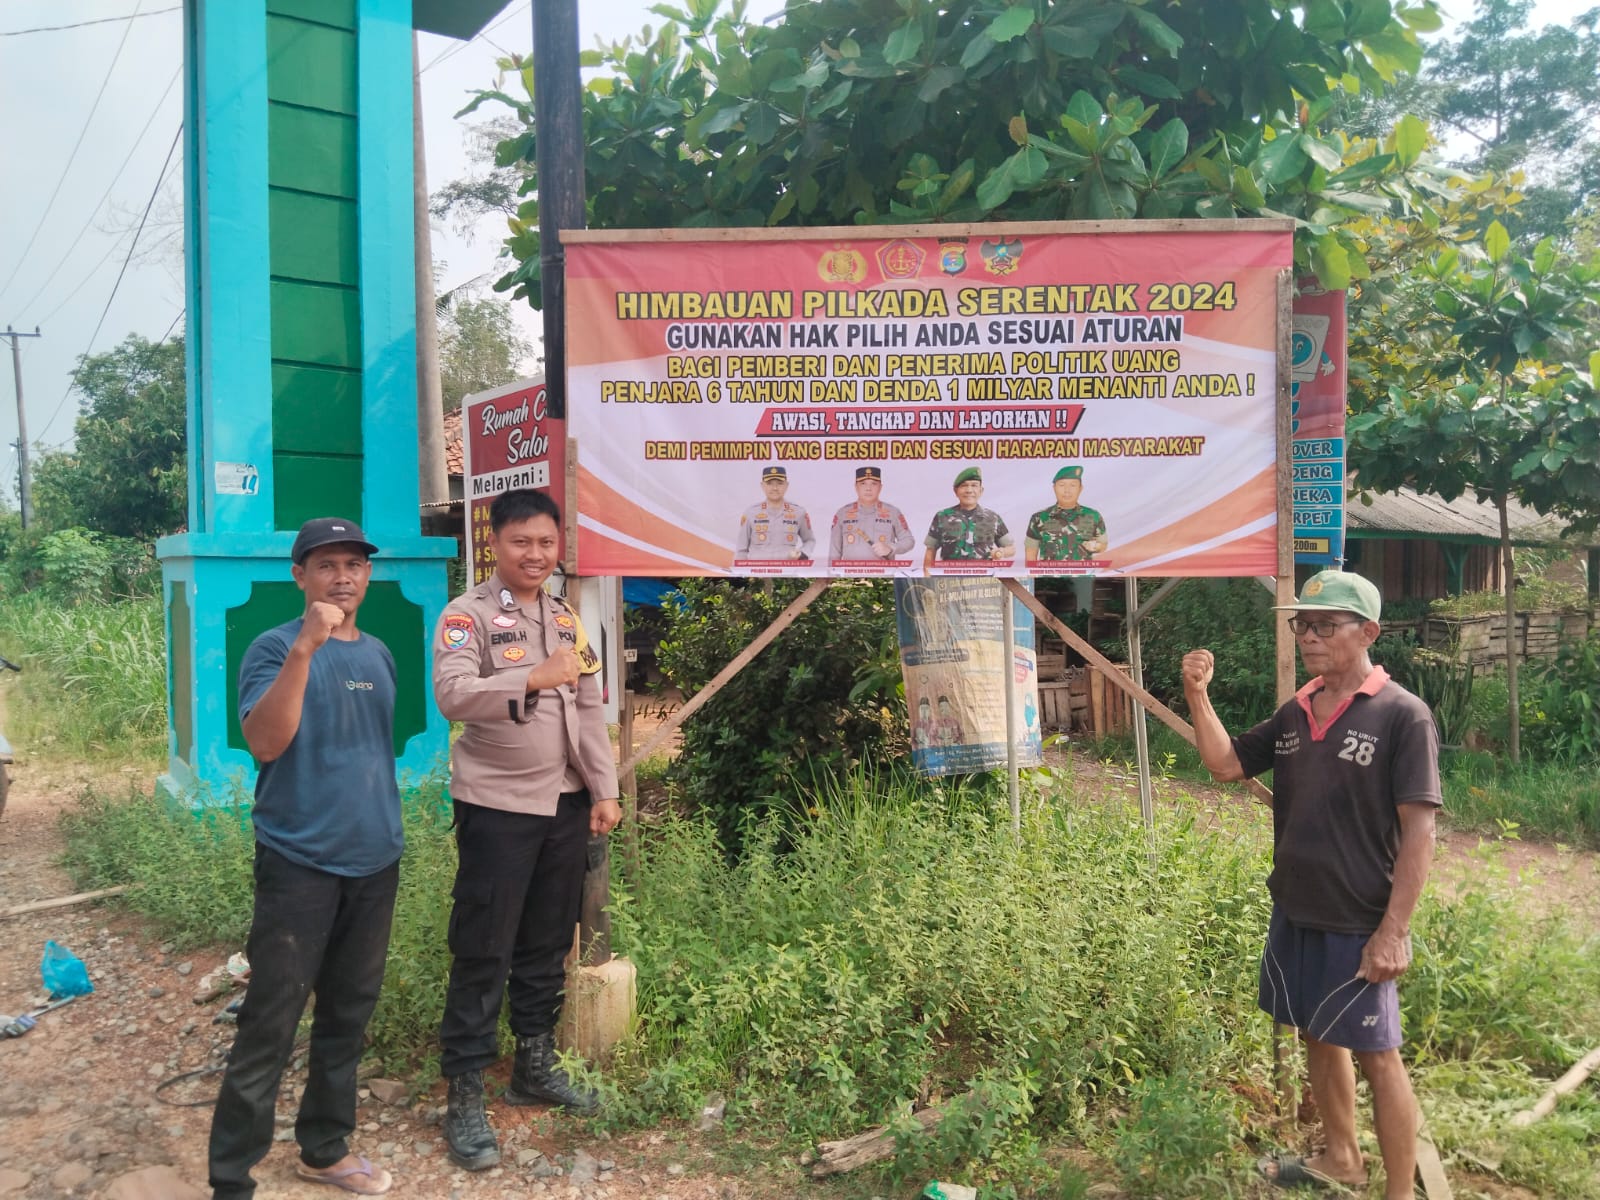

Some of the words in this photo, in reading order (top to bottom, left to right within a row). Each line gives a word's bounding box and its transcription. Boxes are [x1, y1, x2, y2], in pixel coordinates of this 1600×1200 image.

[617, 291, 793, 319] HIMBAUAN
[802, 289, 949, 318] PILKADA
[958, 283, 1140, 315] SERENTAK
[1149, 282, 1237, 311] 2024
[667, 324, 782, 349] GUNAKAN
[789, 324, 838, 348] HAK
[847, 323, 908, 347] PILIH
[915, 321, 979, 347] ANDA
[988, 319, 1074, 345] SESUAI
[1082, 317, 1182, 342] ATURAN
[668, 356, 720, 378] BAGI
[728, 355, 826, 378] PEMBERI
[833, 355, 879, 377] DAN
[887, 352, 1004, 377] PENERIMA
[1012, 351, 1105, 374] POLITIK
[1113, 349, 1179, 373] UANG
[601, 380, 703, 402] PENJARA
[707, 381, 721, 403] 6
[727, 380, 803, 402] TAHUN
[811, 380, 856, 402] DAN
[863, 379, 941, 401] DENDA
[948, 379, 959, 401] 1
[967, 378, 1053, 400] MILYAR
[1059, 375, 1166, 398] MENANTI
[1173, 373, 1241, 397] ANDA
[1247, 373, 1256, 396] !
[481, 398, 529, 437] Rumah
[533, 389, 548, 421] C
[771, 412, 831, 433] AWASI,
[835, 411, 915, 431] TANGKAP
[919, 410, 954, 430] DAN
[958, 410, 1051, 429] LAPORKAN
[1055, 409, 1068, 428] !!
[645, 441, 686, 460] DEMI
[690, 441, 771, 460] PEMIMPIN
[775, 441, 820, 460] YANG
[825, 440, 888, 460] BERSIH
[891, 440, 925, 459] DAN
[931, 440, 993, 459] SESUAI
[997, 438, 1079, 458] HARAPAN
[1083, 436, 1205, 457] MASYARAKAT
[1293, 442, 1332, 457] OVER
[473, 466, 535, 495] Melayani
[1294, 511, 1332, 525] RPET
[558, 631, 576, 645] POL
[1337, 736, 1375, 766] 28
[1358, 732, 1379, 744] URUT
